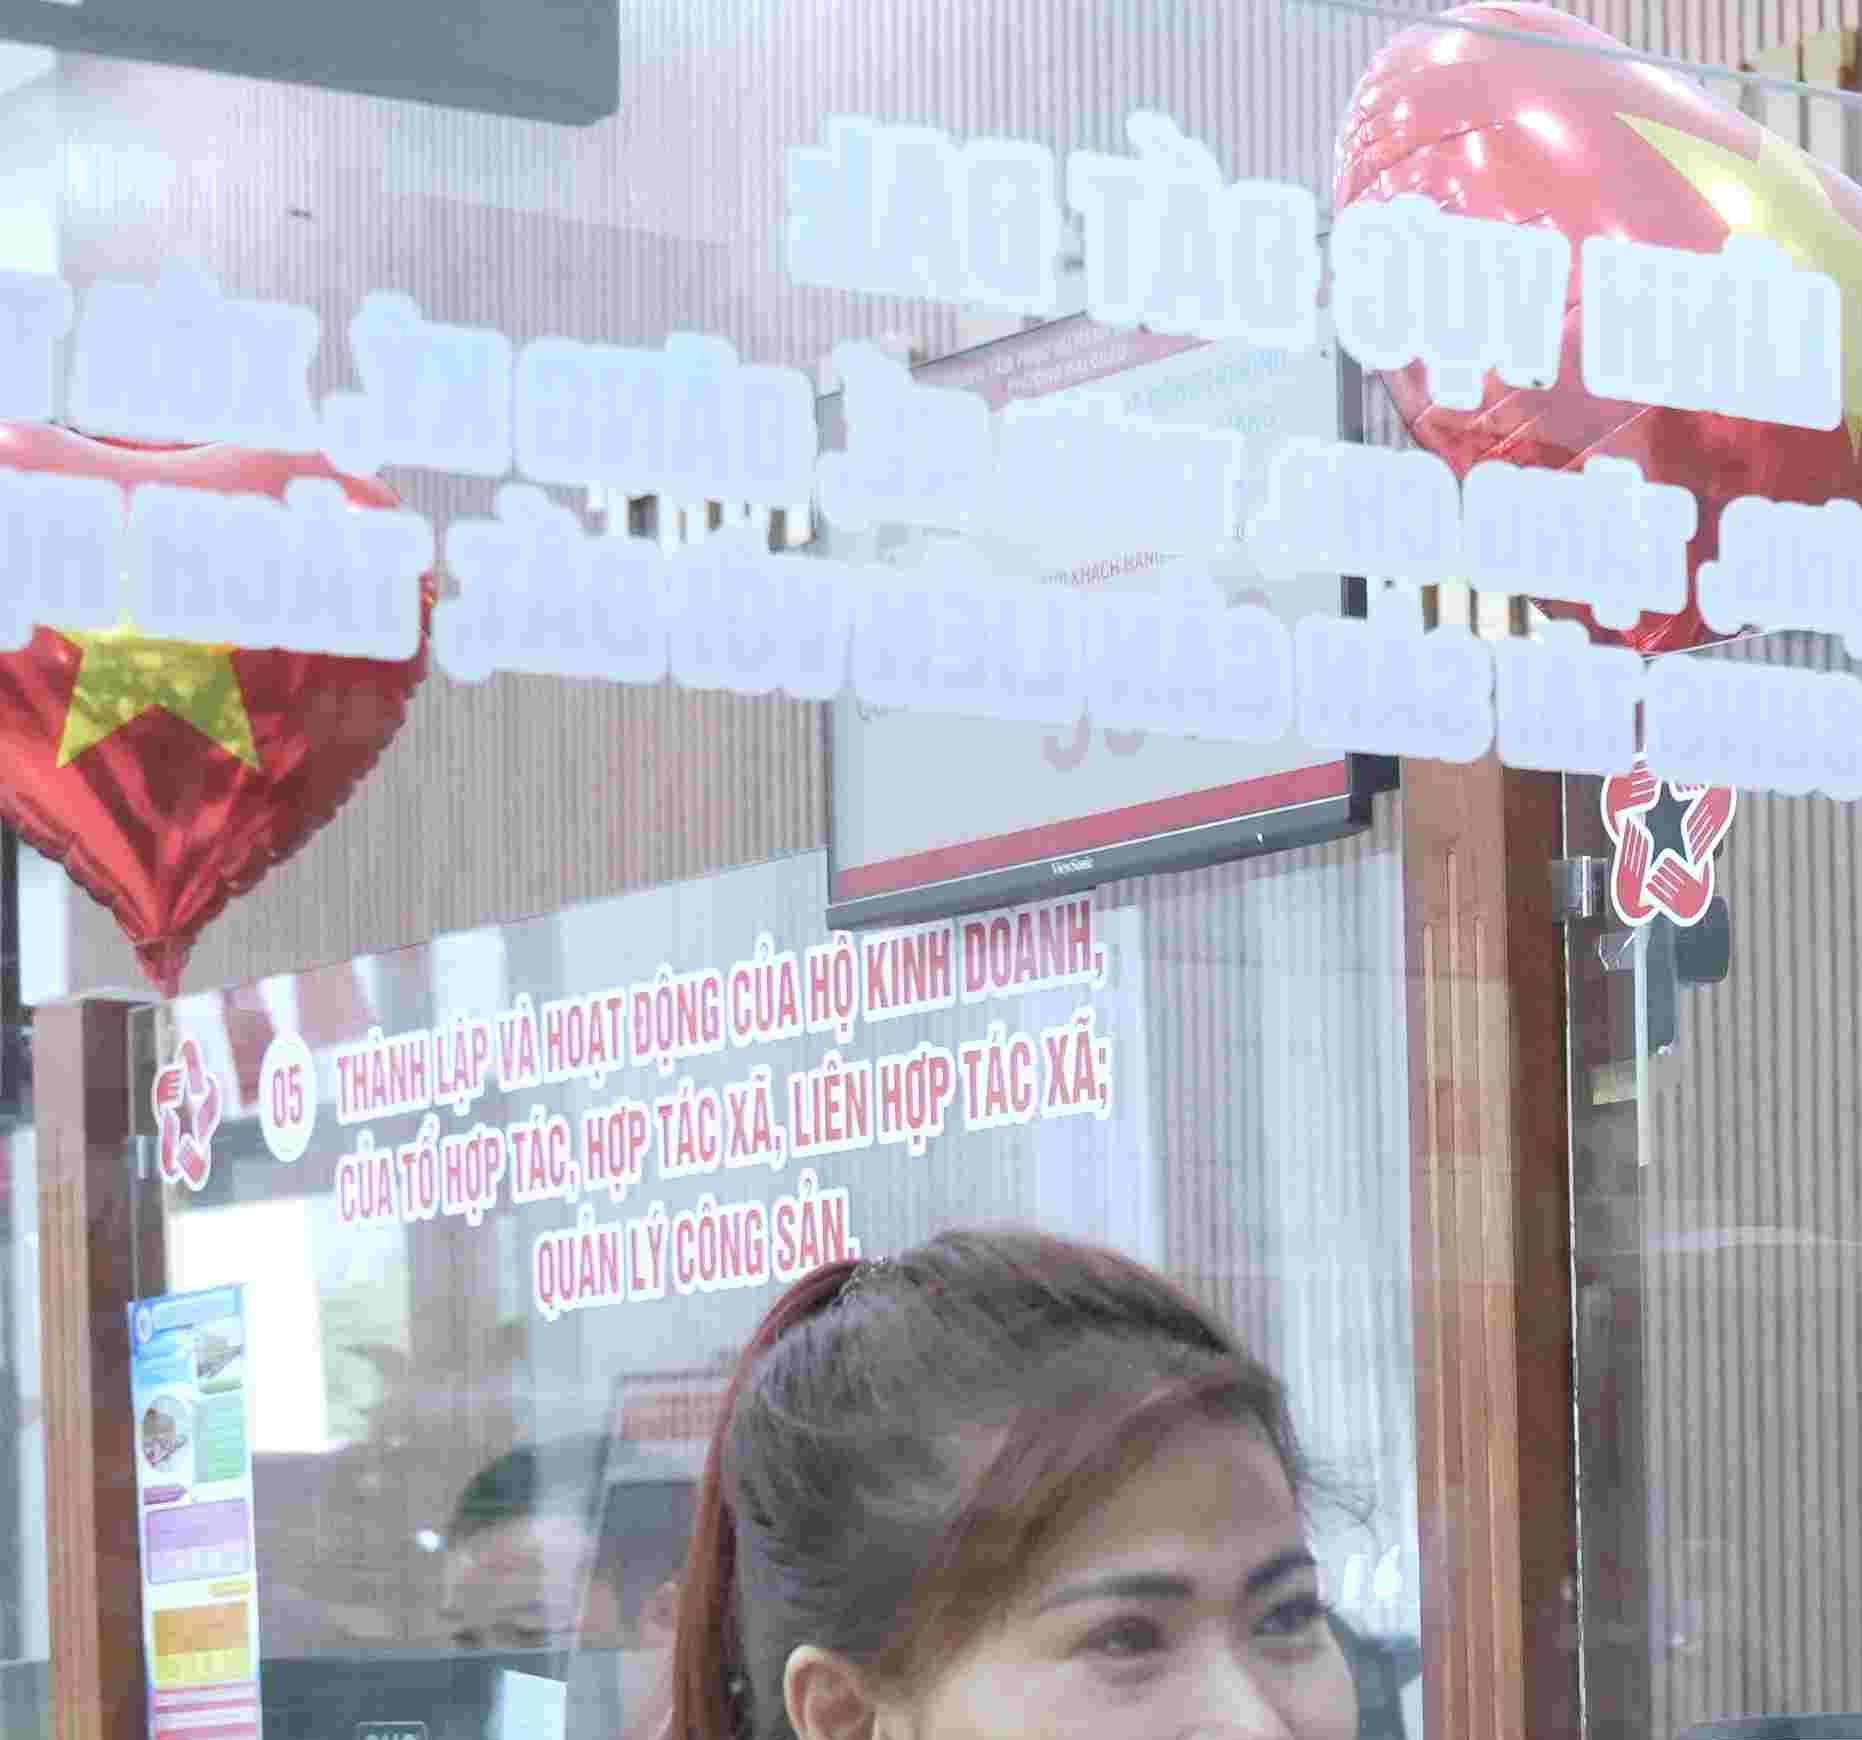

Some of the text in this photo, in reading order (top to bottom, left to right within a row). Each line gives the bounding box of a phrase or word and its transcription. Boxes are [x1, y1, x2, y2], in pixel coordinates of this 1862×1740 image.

[337, 898, 1104, 1119] THÀNH LẬP VÀ HOẠT ĐỘNG CỦA HỘ KINH DOANH,
[271, 1066, 304, 1128] 05
[340, 1137, 394, 1223] CỦA
[446, 1130, 502, 1215] HỢP
[585, 1105, 649, 1197] HỢP
[657, 1088, 717, 1169] TÁC
[728, 1075, 784, 1163] XÃ,
[792, 1058, 869, 1149] LIÊN
[880, 1049, 952, 1147] HỢP
[961, 1029, 1032, 1121] TÁC
[1047, 1014, 1107, 1108] XÃ;
[537, 1207, 620, 1307] QUẢN
[630, 1204, 664, 1291] LÝ
[675, 1199, 764, 1283] CÔNG
